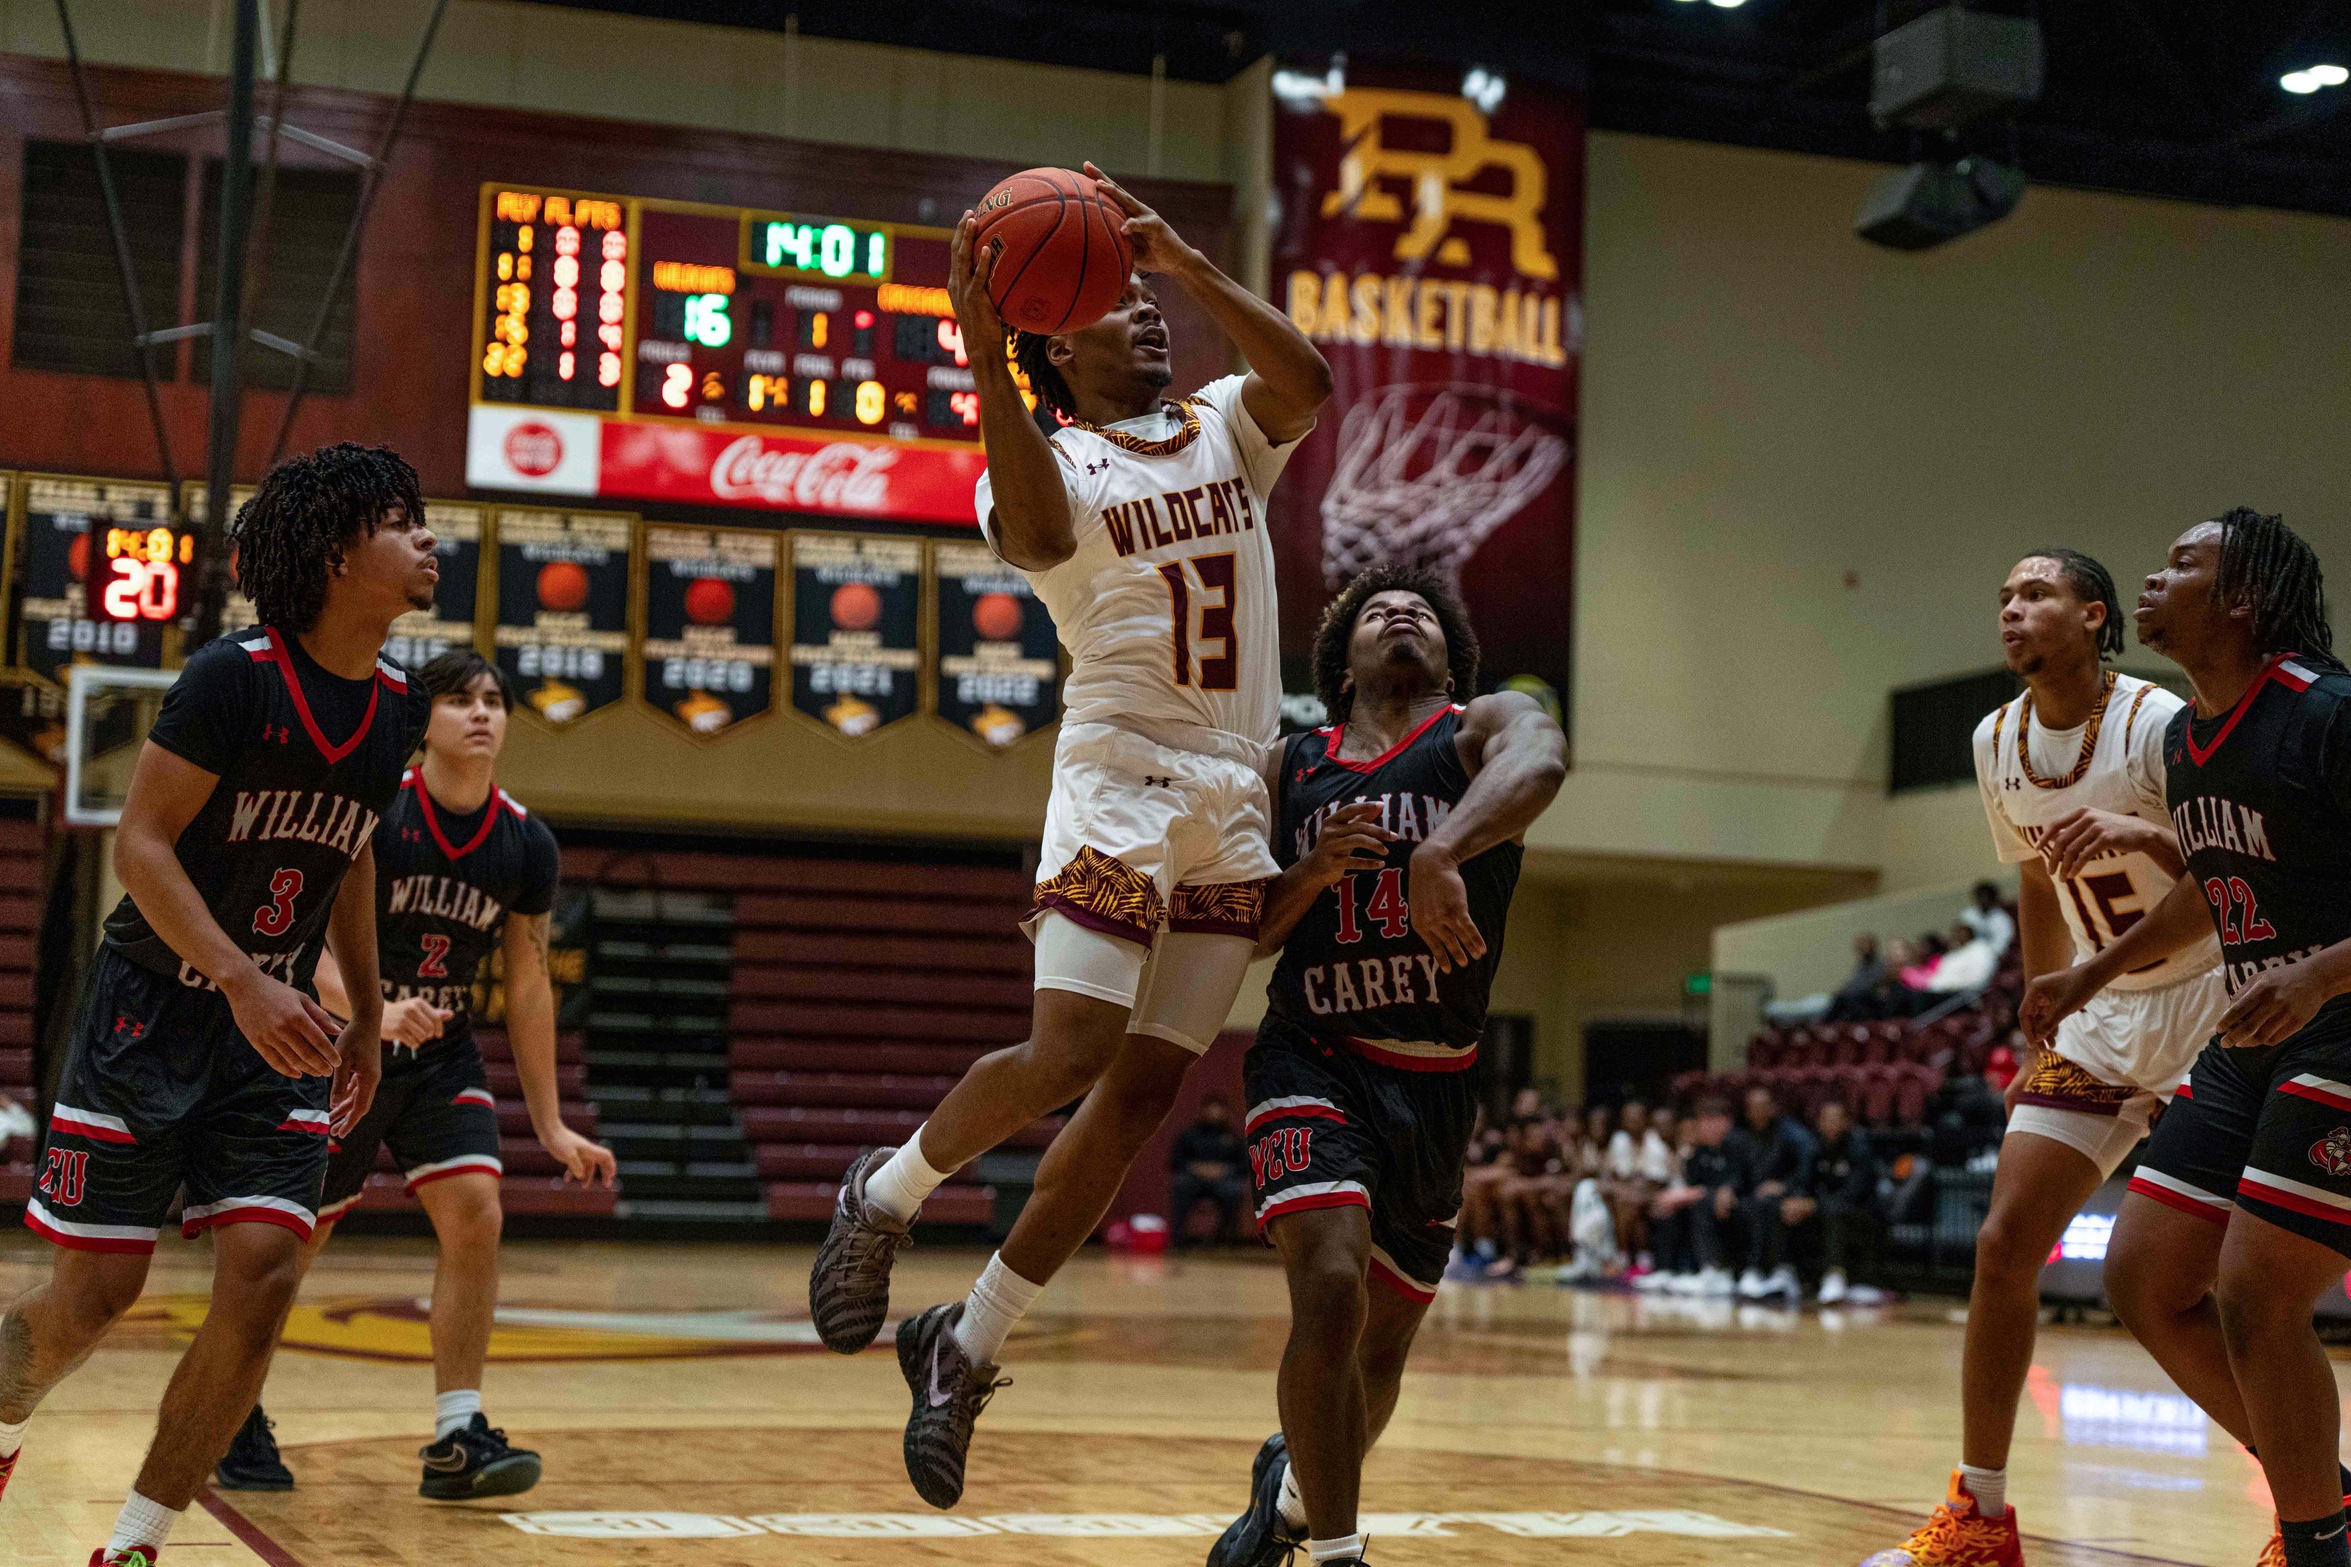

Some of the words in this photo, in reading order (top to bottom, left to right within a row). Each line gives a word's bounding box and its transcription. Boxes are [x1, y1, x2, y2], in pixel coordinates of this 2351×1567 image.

[766, 221, 885, 278] 14:01
[684, 292, 732, 348] 16
[1287, 268, 1563, 368] BASKETBALL
[1101, 476, 1254, 558] WILDCATS
[104, 556, 180, 620] 20
[1153, 550, 1239, 693] 13
[228, 790, 380, 861] WILLIAM
[2173, 796, 2276, 866] ILLIAM
[252, 866, 304, 937] 3
[388, 874, 501, 932] WILLIAM
[1330, 867, 1409, 944] 14
[2204, 876, 2278, 946] 22
[417, 932, 451, 978] 2
[1304, 954, 1441, 1015] CAREY
